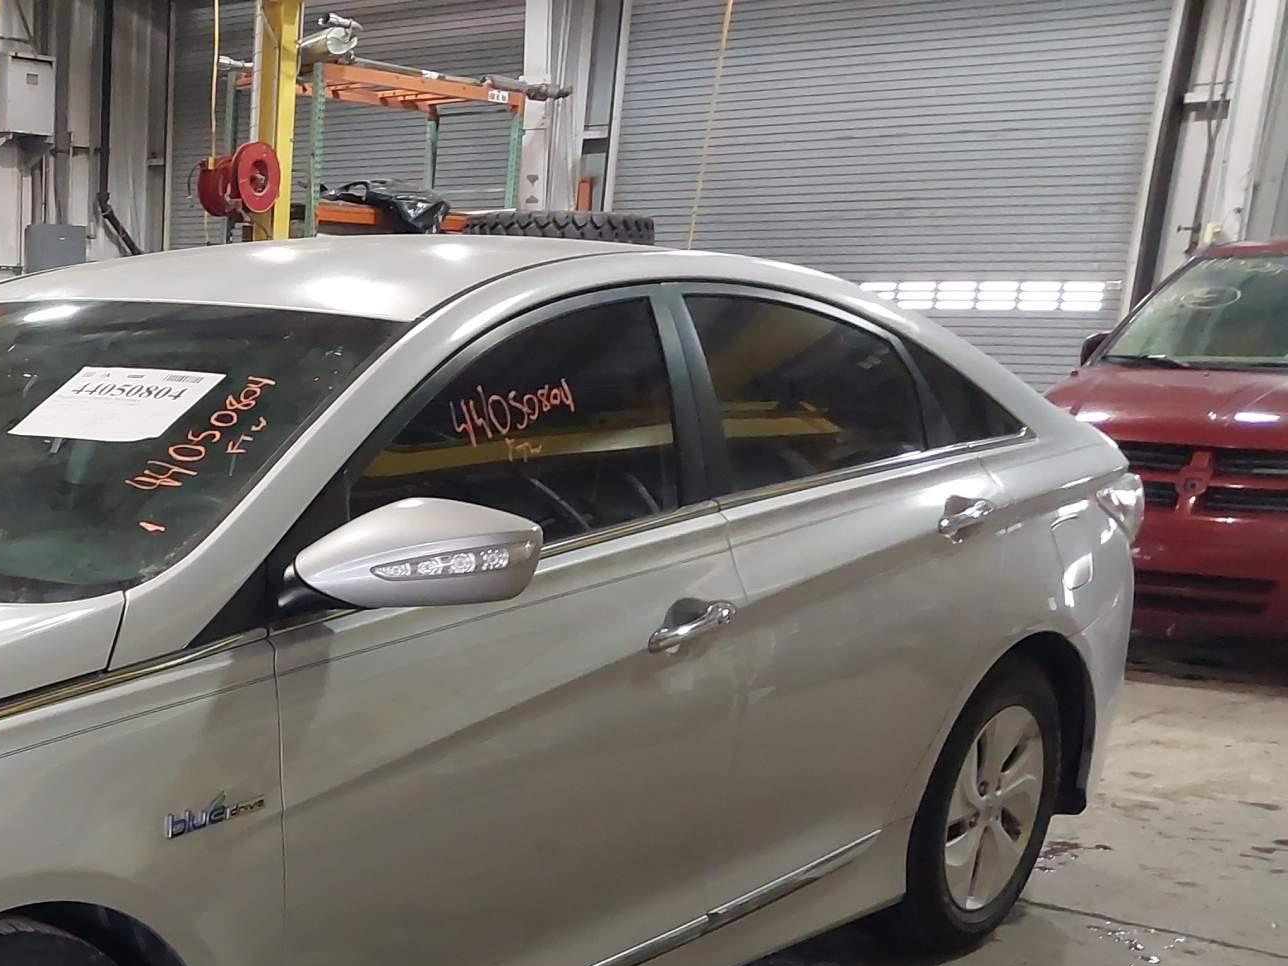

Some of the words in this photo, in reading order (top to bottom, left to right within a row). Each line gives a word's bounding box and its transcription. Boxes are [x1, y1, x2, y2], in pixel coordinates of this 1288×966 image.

[72, 383, 188, 401] 44050804
[449, 378, 576, 447] 44050804
[124, 375, 276, 490] 44050804
[166, 804, 226, 840] blue
